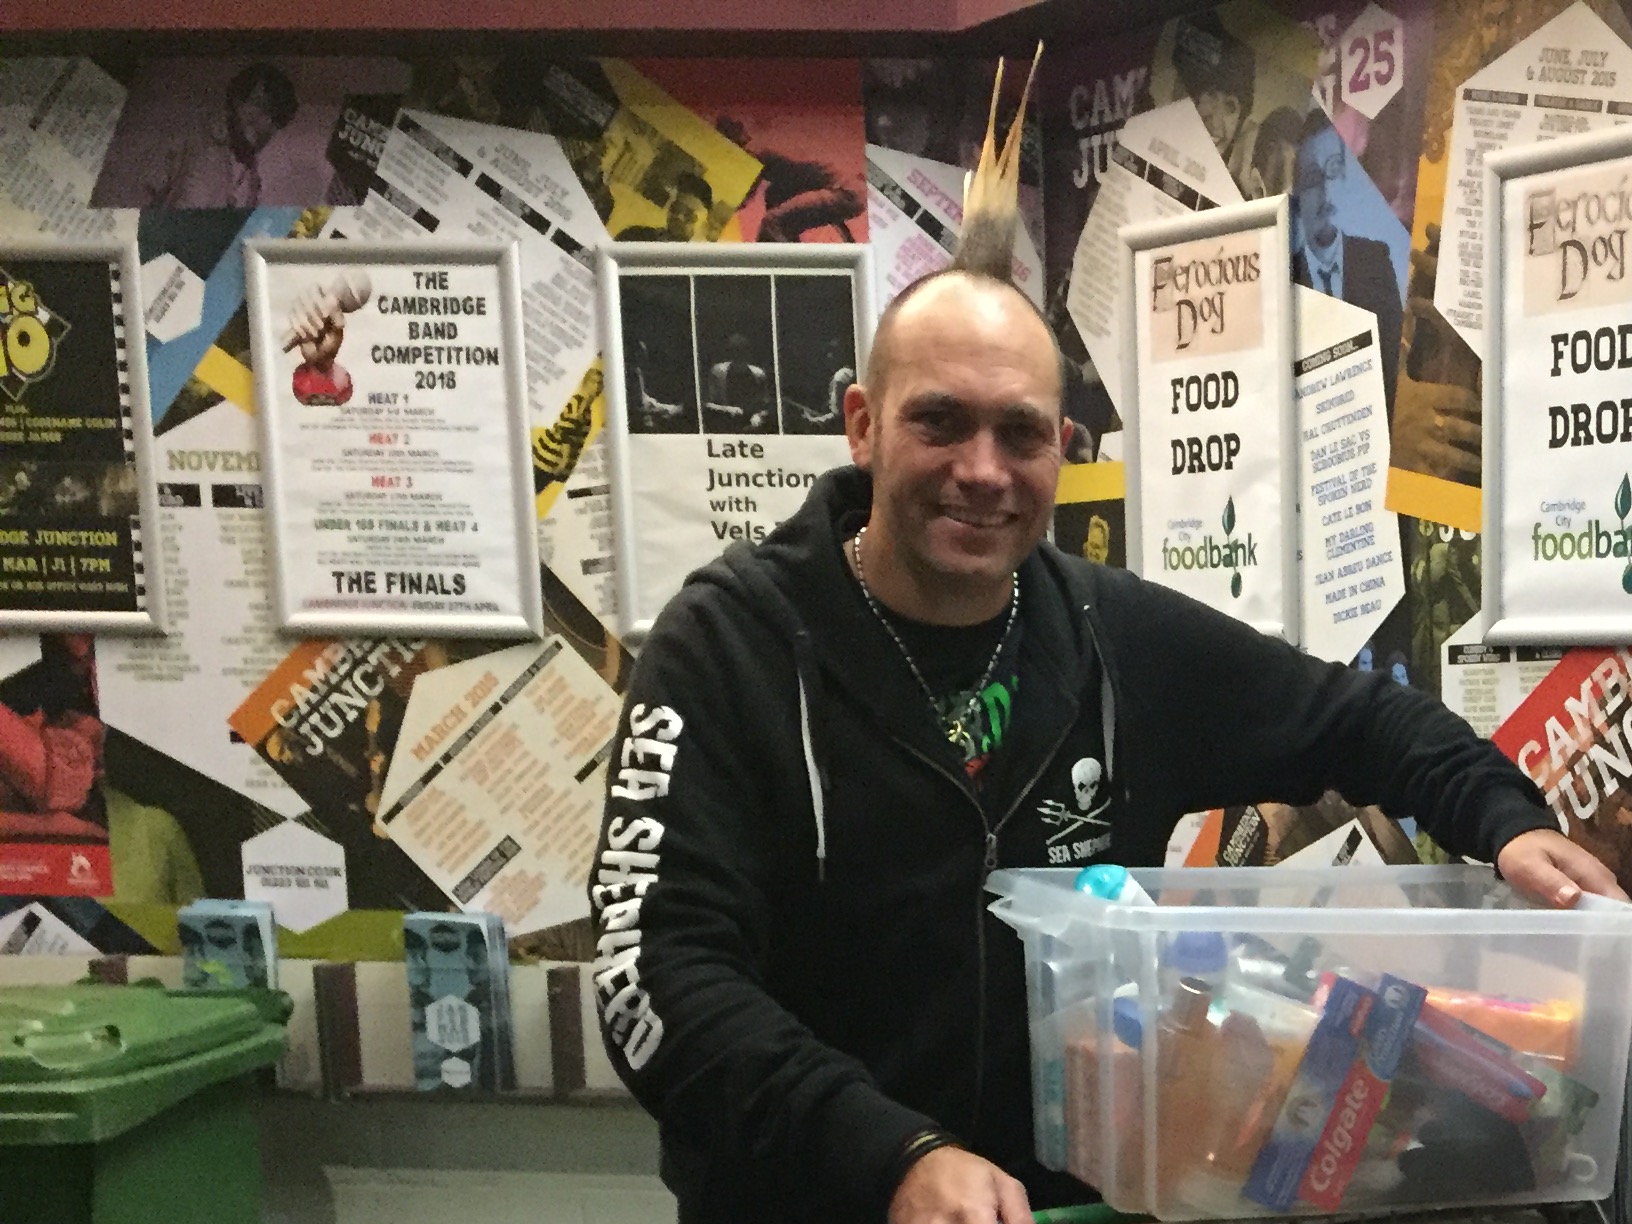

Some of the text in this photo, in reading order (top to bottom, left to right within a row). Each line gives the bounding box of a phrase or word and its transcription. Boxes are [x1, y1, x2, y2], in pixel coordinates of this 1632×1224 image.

[1349, 28, 1396, 94] 25
[1557, 227, 1627, 302] Dog
[413, 271, 449, 290] THE
[1152, 246, 1260, 312] Ferocious
[377, 296, 487, 316] CAMBRIDGE
[408, 321, 458, 340] BAND
[1175, 291, 1225, 350] Dog
[371, 345, 499, 365] COMPETITION
[414, 371, 457, 390] 2018
[1171, 370, 1239, 414] FOOD
[707, 439, 765, 459] Late
[1171, 432, 1241, 475] DROP
[706, 468, 816, 492] Junction
[709, 495, 757, 513] with
[36, 530, 118, 546] JUNCTION
[710, 521, 766, 541] Vels
[1162, 532, 1258, 571] foodbank
[332, 571, 467, 595] THE FINALS
[1047, 844, 1071, 864] SEA
[592, 703, 684, 1071] SEA SHEPHERD
[1309, 1077, 1369, 1193] Colgate
